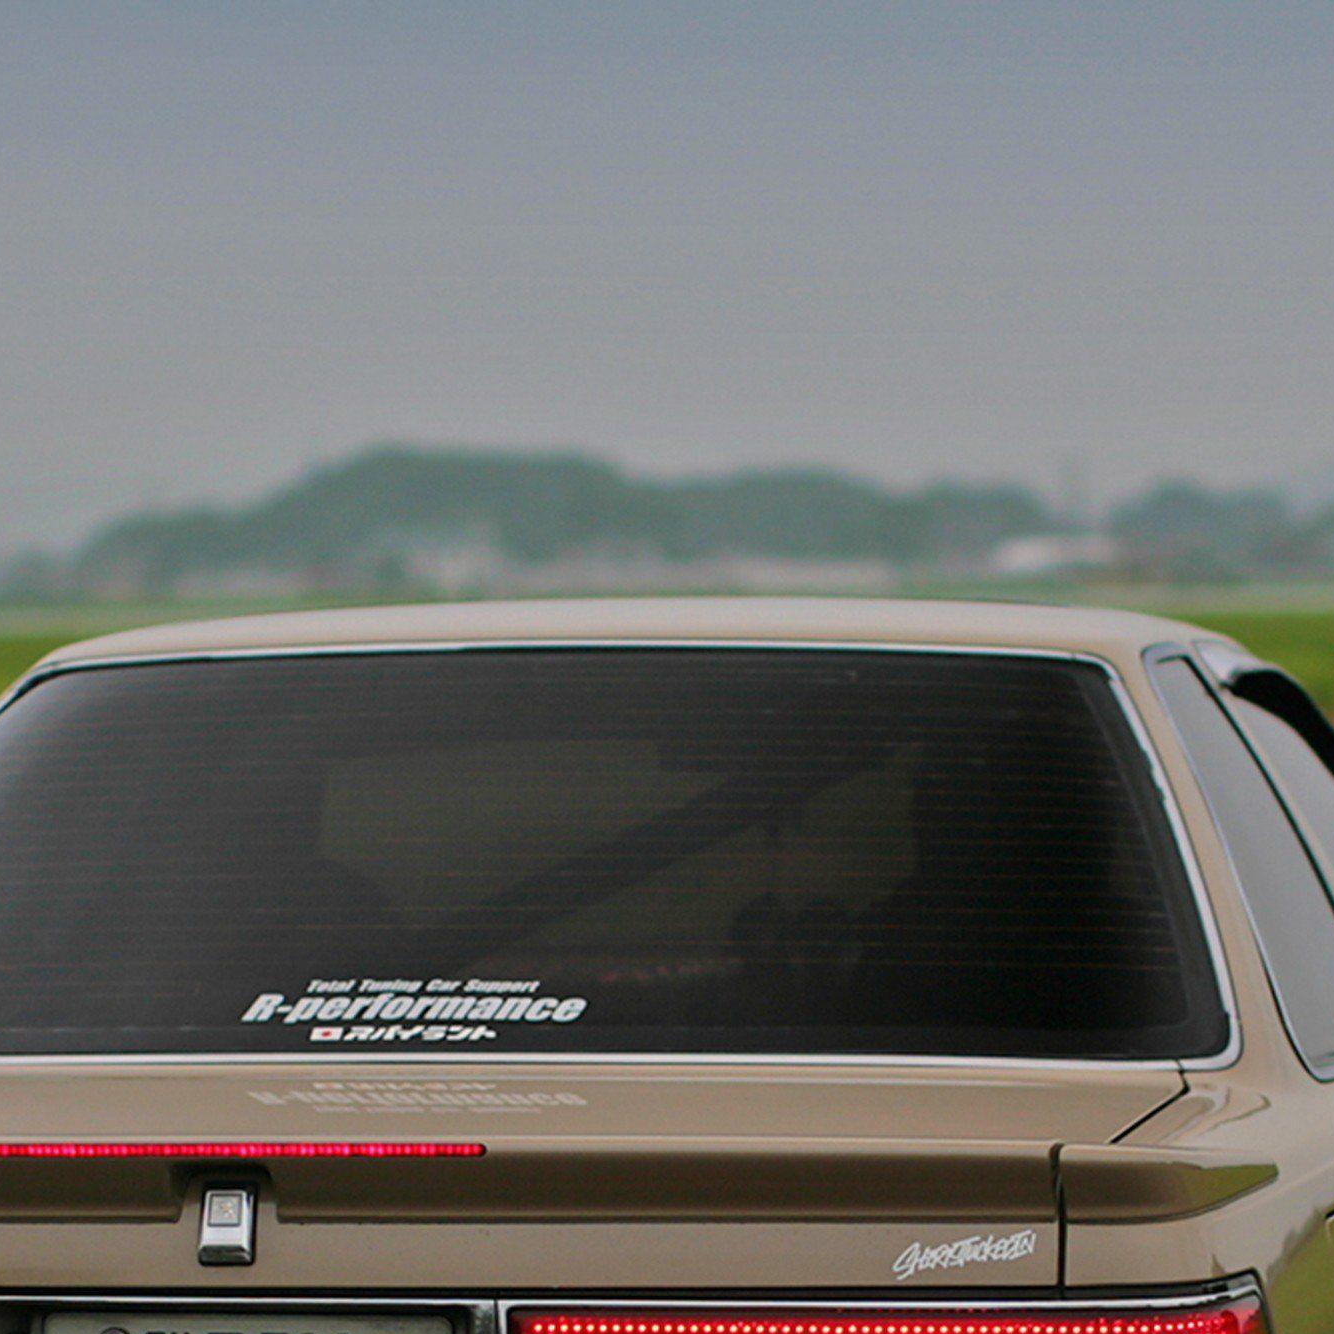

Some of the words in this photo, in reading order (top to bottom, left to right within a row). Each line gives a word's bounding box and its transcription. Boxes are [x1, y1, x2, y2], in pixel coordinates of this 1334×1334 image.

[307, 979, 357, 993] Total
[358, 978, 423, 993] Tuning
[425, 978, 461, 993] Car
[463, 978, 541, 993] Support
[241, 992, 588, 1023] R-performance
